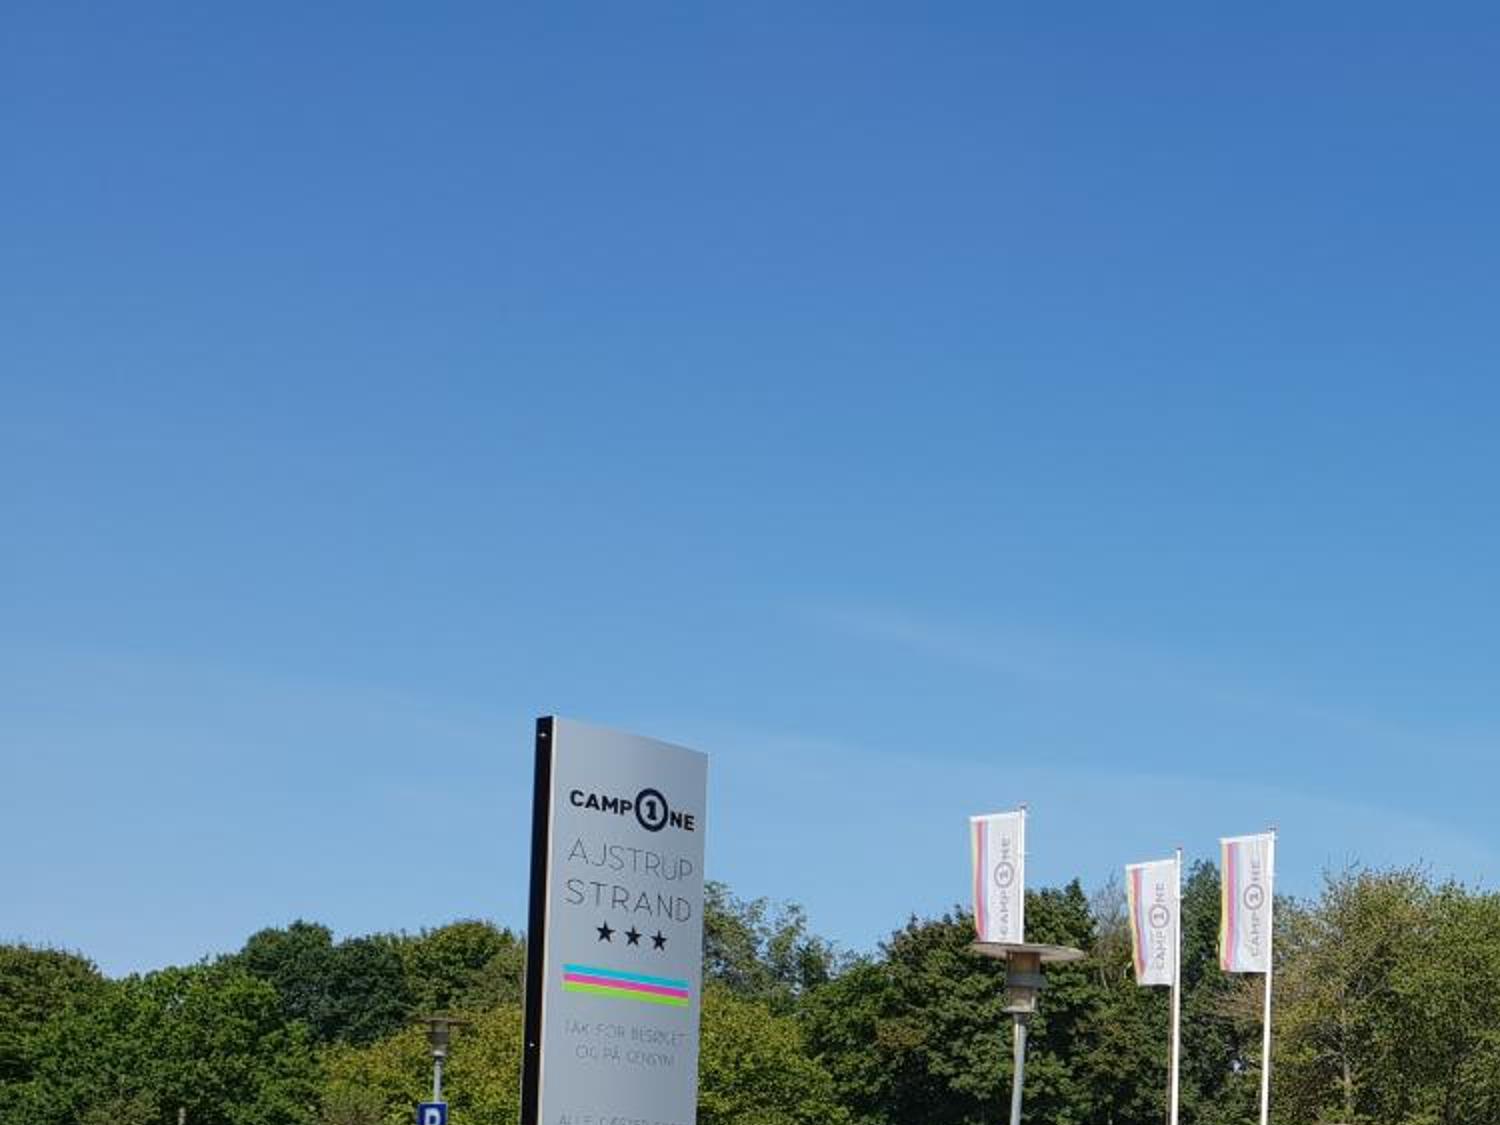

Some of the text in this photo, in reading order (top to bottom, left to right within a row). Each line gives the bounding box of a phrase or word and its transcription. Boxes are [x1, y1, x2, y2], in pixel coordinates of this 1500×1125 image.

[567, 837, 694, 881] AJSTRUP
[566, 878, 692, 922] STRAND
[564, 1019, 589, 1035] TAK
[597, 1023, 625, 1038] FOR
